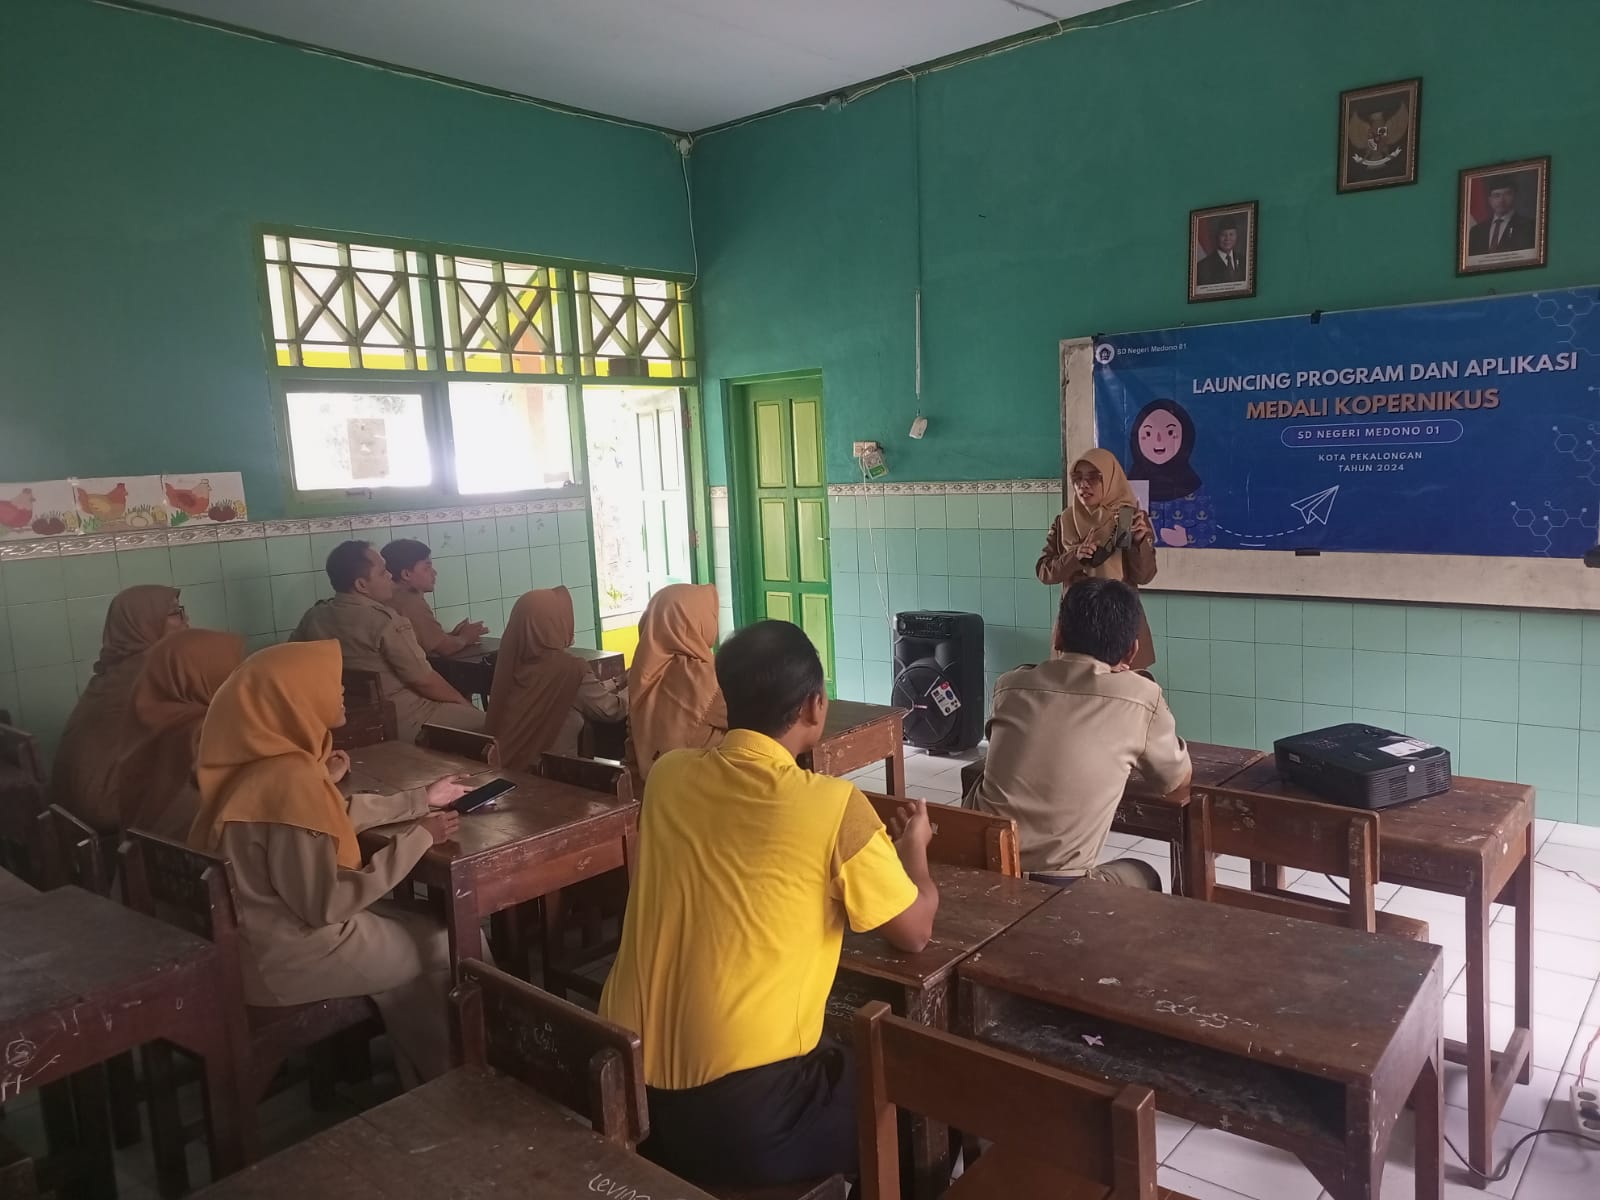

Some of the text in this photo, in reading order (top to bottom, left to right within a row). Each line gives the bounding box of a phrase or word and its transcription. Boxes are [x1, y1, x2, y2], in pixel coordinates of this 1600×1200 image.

[1192, 351, 1578, 394] LAUNCING PROGRAM DAN APLIKASI
[1245, 388, 1500, 420] MEDALI KOPERNIKUS
[1297, 425, 1440, 440] SD NEGERI MEDONO 01
[1318, 451, 1423, 462] KOTA PEKALONGAN
[1338, 463, 1405, 472] TAHUN 2024
